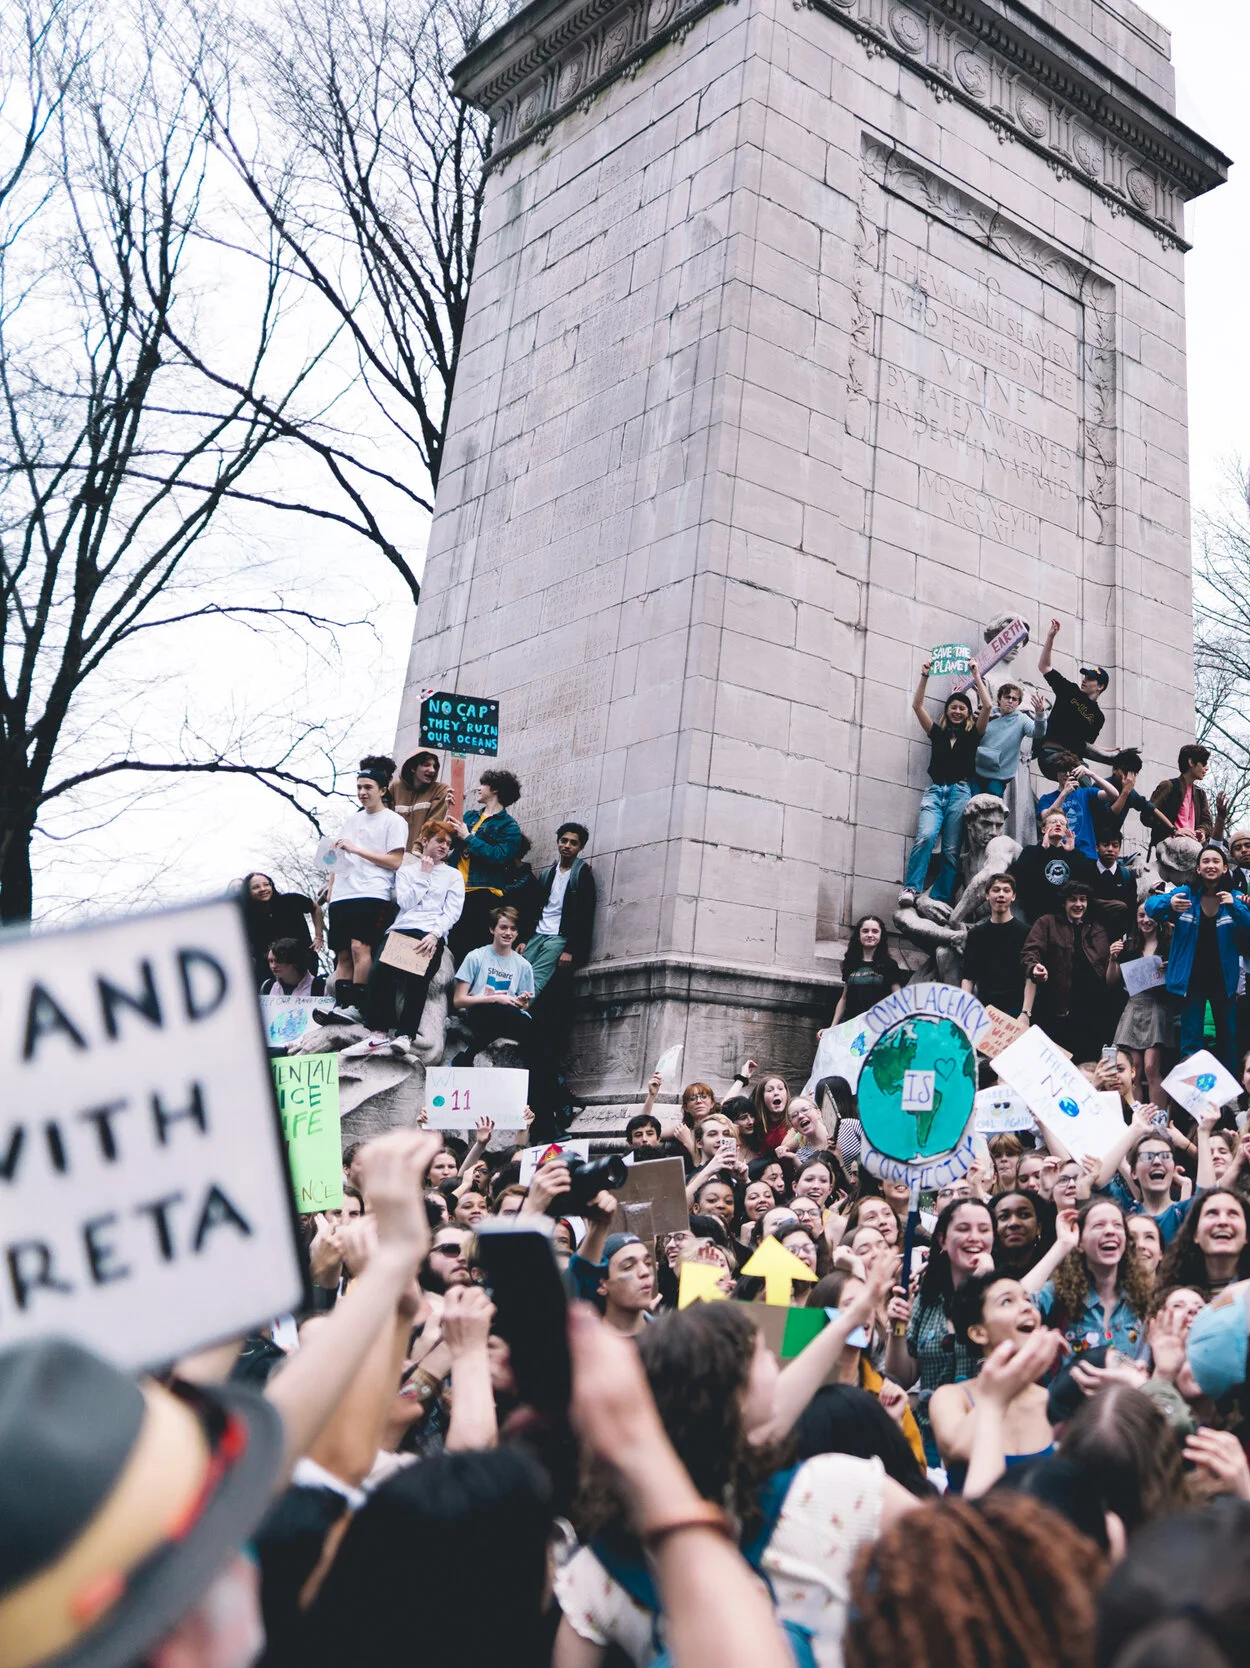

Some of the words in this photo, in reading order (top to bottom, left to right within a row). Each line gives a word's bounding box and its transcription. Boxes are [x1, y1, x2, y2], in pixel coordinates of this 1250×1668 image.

[974, 267, 1001, 297] TO
[892, 254, 928, 289] THE
[1006, 317, 1073, 369] SEAMEN
[891, 287, 938, 328] WHO
[942, 314, 1021, 371] PERISHED
[887, 365, 912, 393] BY
[939, 348, 1027, 415] MAINE
[911, 411, 977, 460] DEATH
[990, 619, 1024, 654] EARTH
[932, 646, 952, 660] SAVE
[953, 646, 971, 659] THE
[933, 660, 970, 675] PLANET
[429, 699, 452, 715] NO
[457, 703, 488, 719] CAP
[427, 717, 460, 731] THEY
[466, 723, 498, 737] RUIN
[427, 731, 451, 743] OUR
[457, 734, 498, 750] OCEANS
[23, 947, 229, 1062] AND
[865, 985, 990, 1041] COMPLACENCY
[903, 1073, 932, 1104] IS
[283, 1109, 323, 1138] IFE
[6, 1182, 255, 1313] RETA
